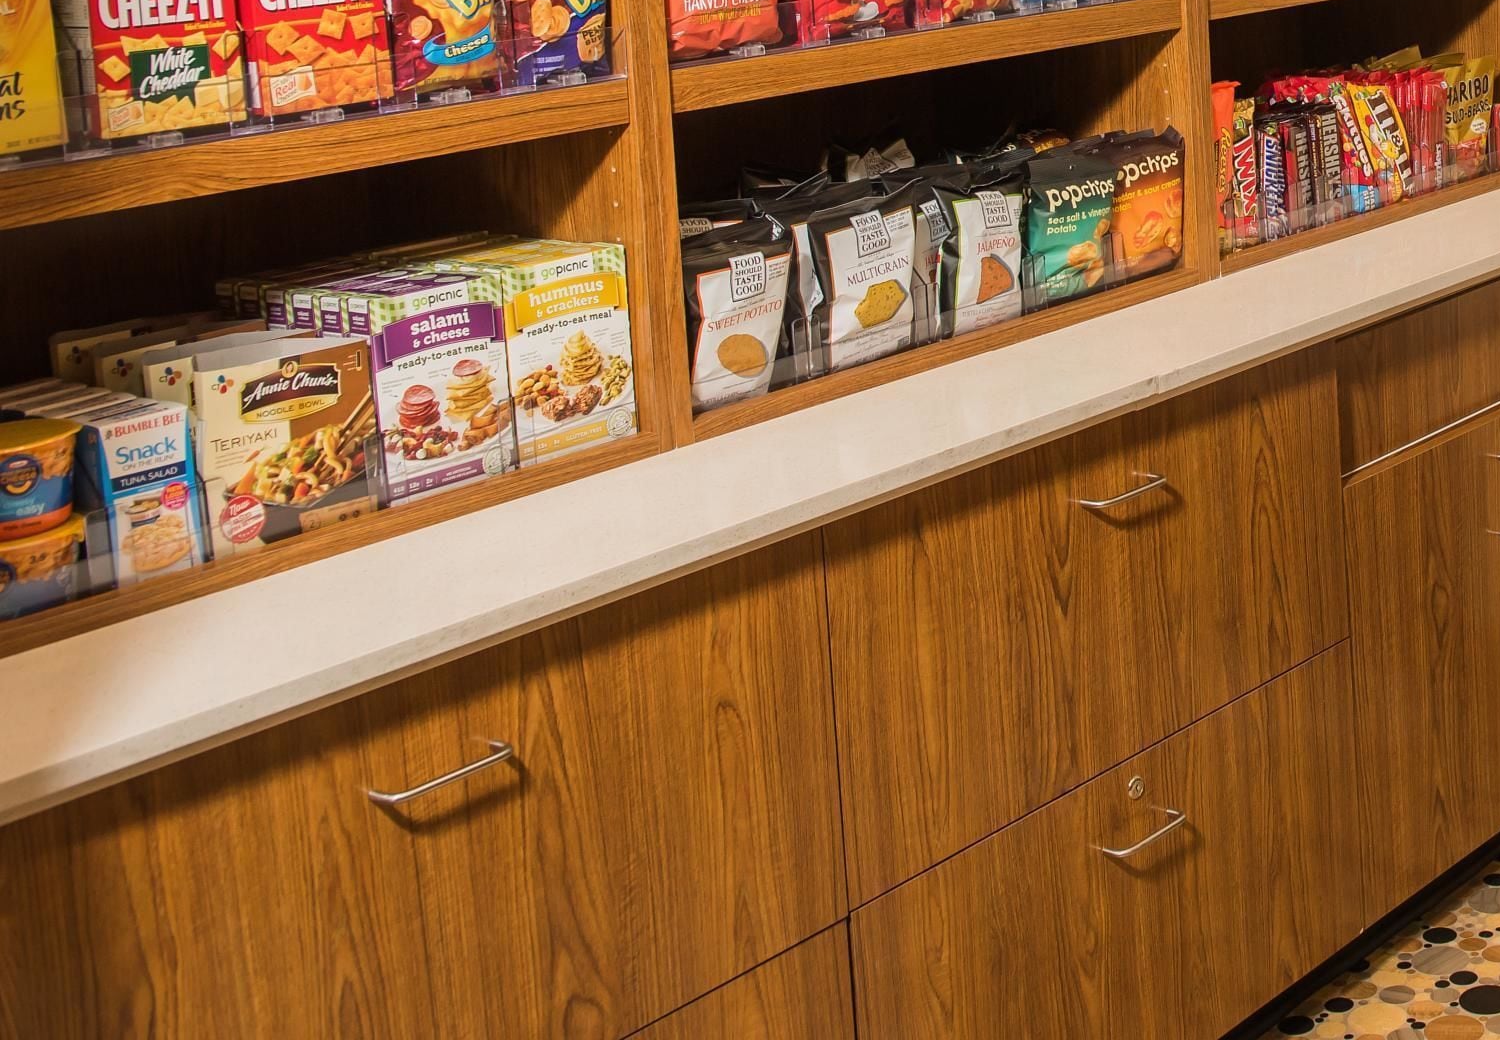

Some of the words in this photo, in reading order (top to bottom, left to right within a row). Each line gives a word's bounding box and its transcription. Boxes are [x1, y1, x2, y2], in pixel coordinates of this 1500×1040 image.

[444, 34, 490, 59] Cheese
[150, 46, 196, 76] White
[139, 64, 205, 100] Cheddar
[1446, 74, 1490, 107] HARIBO
[1446, 98, 1491, 125] GOLD-BEARS
[1115, 151, 1180, 188] opchips
[1232, 125, 1258, 217] TWIX
[1264, 136, 1280, 218] SNICKERS
[1046, 177, 1115, 214] popchips
[855, 214, 879, 228] FOOD
[986, 207, 1006, 216] TASTE
[987, 215, 1009, 225] GOOD
[1048, 216, 1065, 226] sea
[1066, 211, 1081, 223] salt
[859, 222, 882, 233] SHOULD
[860, 230, 885, 243] TASTE
[1047, 224, 1078, 236] potato
[861, 238, 888, 253] GOOD
[976, 236, 1016, 256] JALAPEÑO
[540, 259, 588, 281] gopicnic
[734, 256, 761, 268] FOOD
[735, 266, 763, 277] SHOULD
[847, 257, 909, 287] MULTIGRAIN
[735, 274, 763, 286] TASTE
[735, 283, 763, 297] GOOD
[412, 287, 463, 311] gopicnic
[529, 278, 604, 308] hummus
[536, 307, 543, 319] &
[546, 294, 600, 315] crackers
[707, 312, 743, 333] SWEET
[743, 299, 783, 322] POTATO
[410, 308, 470, 337] salami
[527, 313, 587, 338] ready-to-eat
[589, 310, 612, 322] meal
[412, 337, 420, 349] &
[423, 326, 470, 347] cheese
[397, 346, 462, 372] ready-to-eat
[464, 342, 489, 355] meal
[242, 378, 291, 408] Annie
[290, 371, 339, 391] Chun's
[256, 404, 295, 420] NOODLE
[299, 398, 325, 412] BOWL
[114, 416, 160, 438] BUMBLE
[162, 412, 182, 426] BEE
[115, 436, 177, 465] Snack
[210, 427, 279, 453] TERIYAKI
[120, 472, 146, 488] TUNA
[147, 466, 178, 480] SALAD
